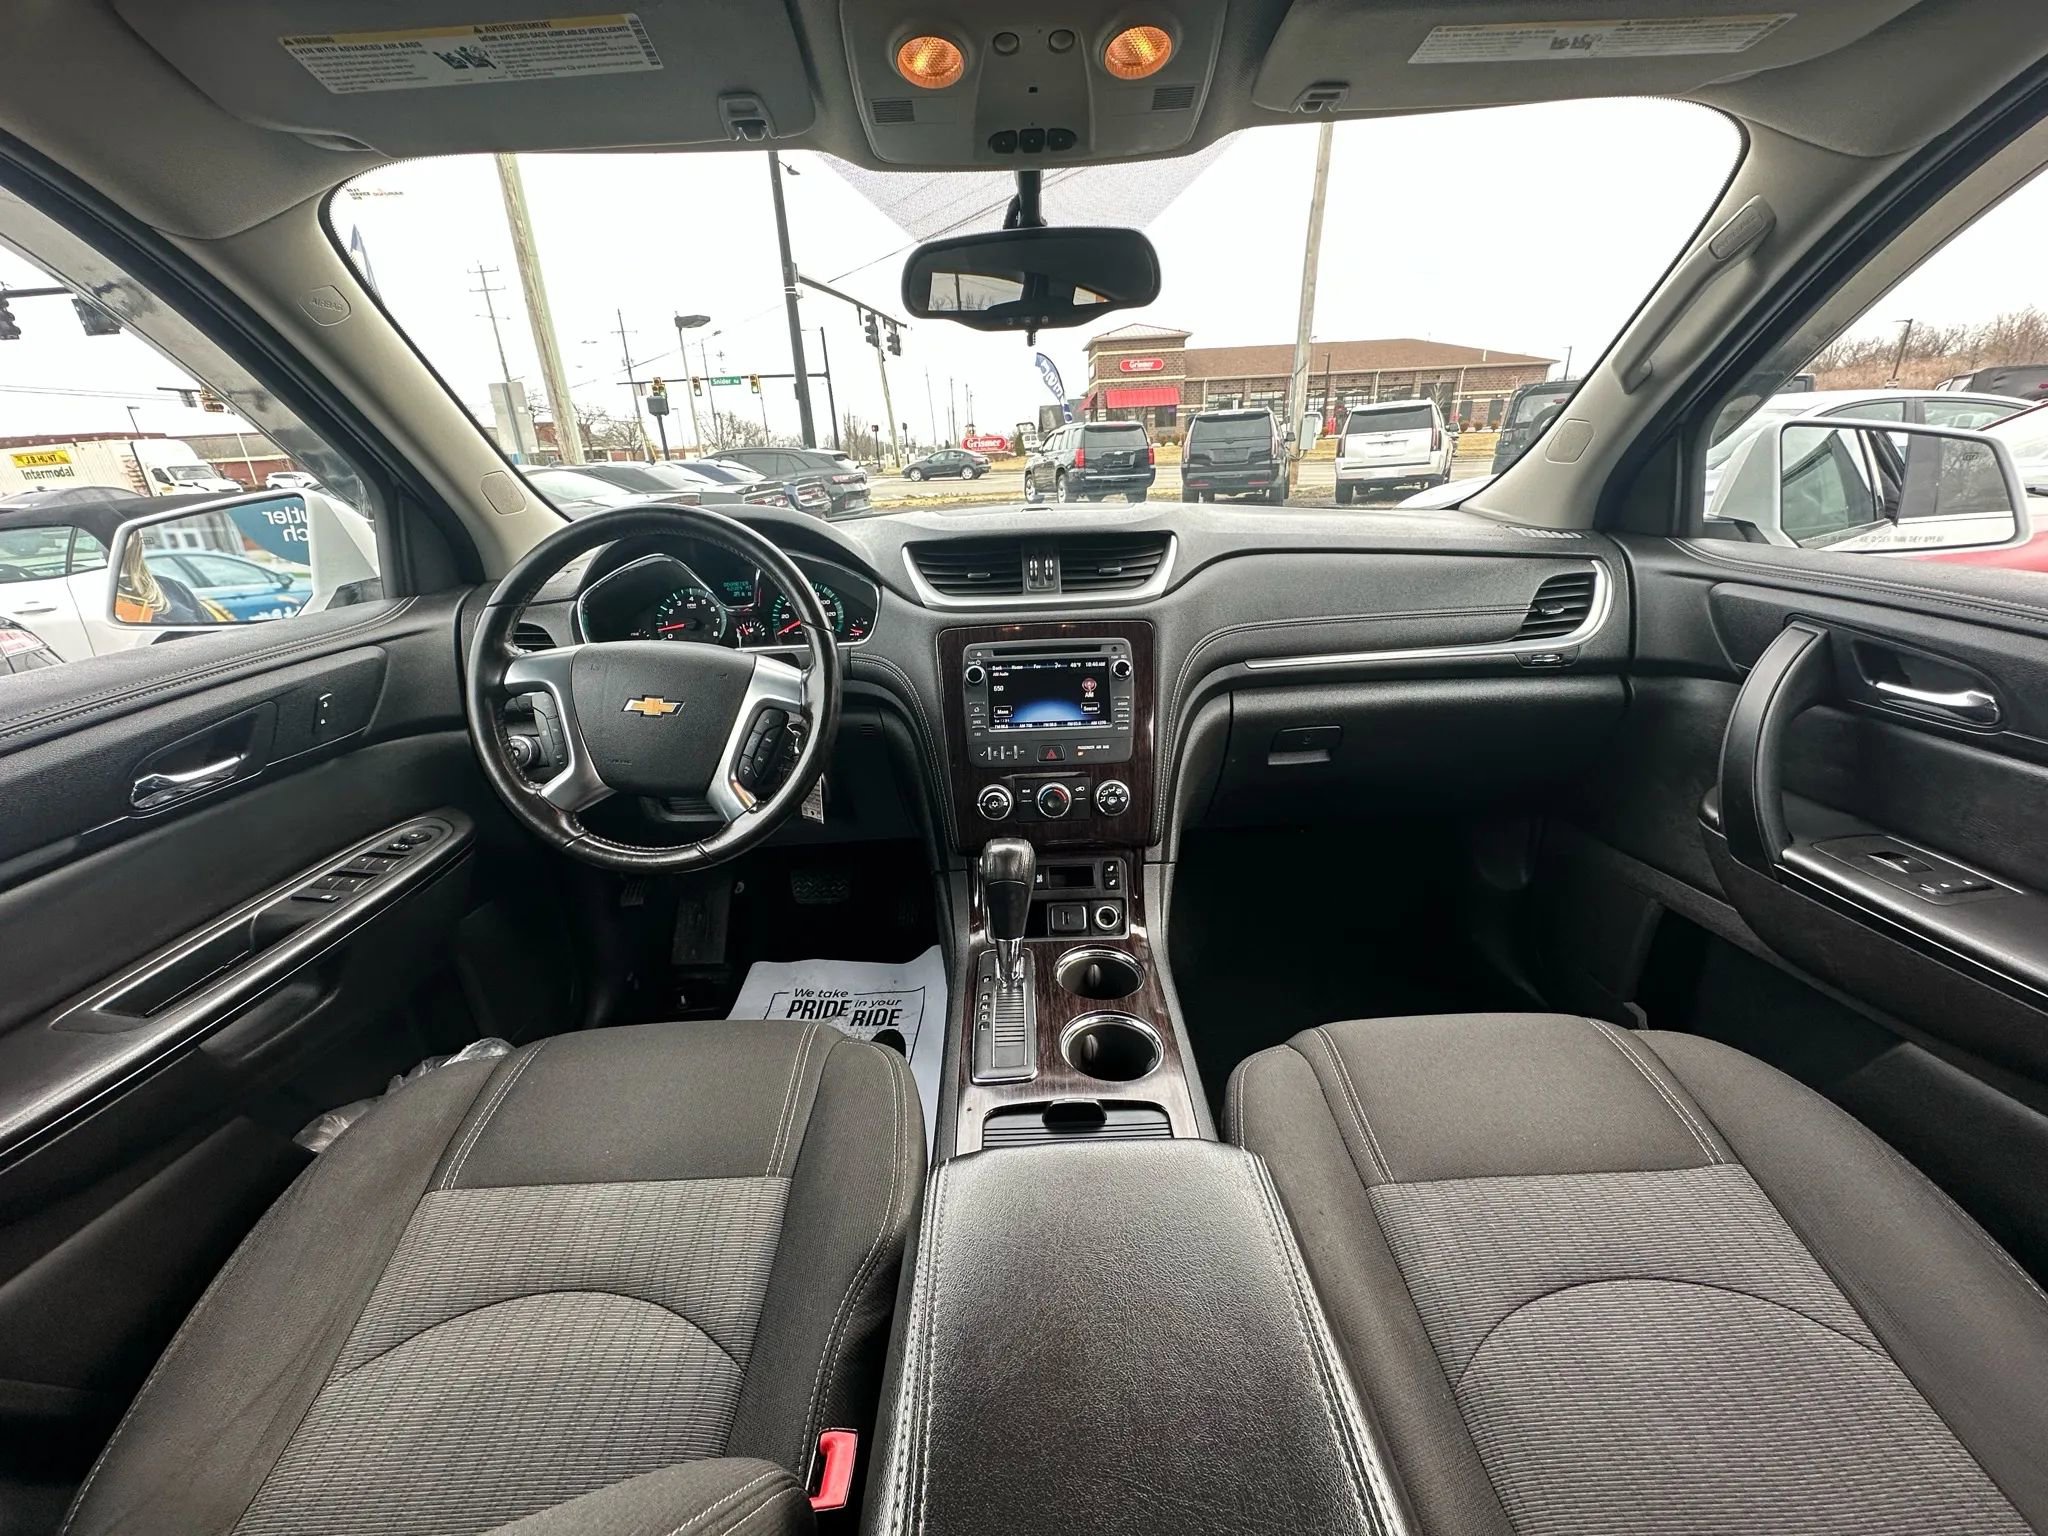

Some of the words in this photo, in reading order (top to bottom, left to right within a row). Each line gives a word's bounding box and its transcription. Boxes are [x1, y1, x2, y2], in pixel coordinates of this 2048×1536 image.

[337, 44, 382, 52] ADVANCED
[967, 438, 1002, 448] Grismer
[21, 466, 75, 480] Intermodal
[794, 988, 814, 998] We
[818, 988, 849, 998] take
[786, 1000, 852, 1019] PRIDE
[854, 999, 866, 1008] in
[870, 999, 902, 1008] your
[850, 1008, 902, 1026] RIDE
